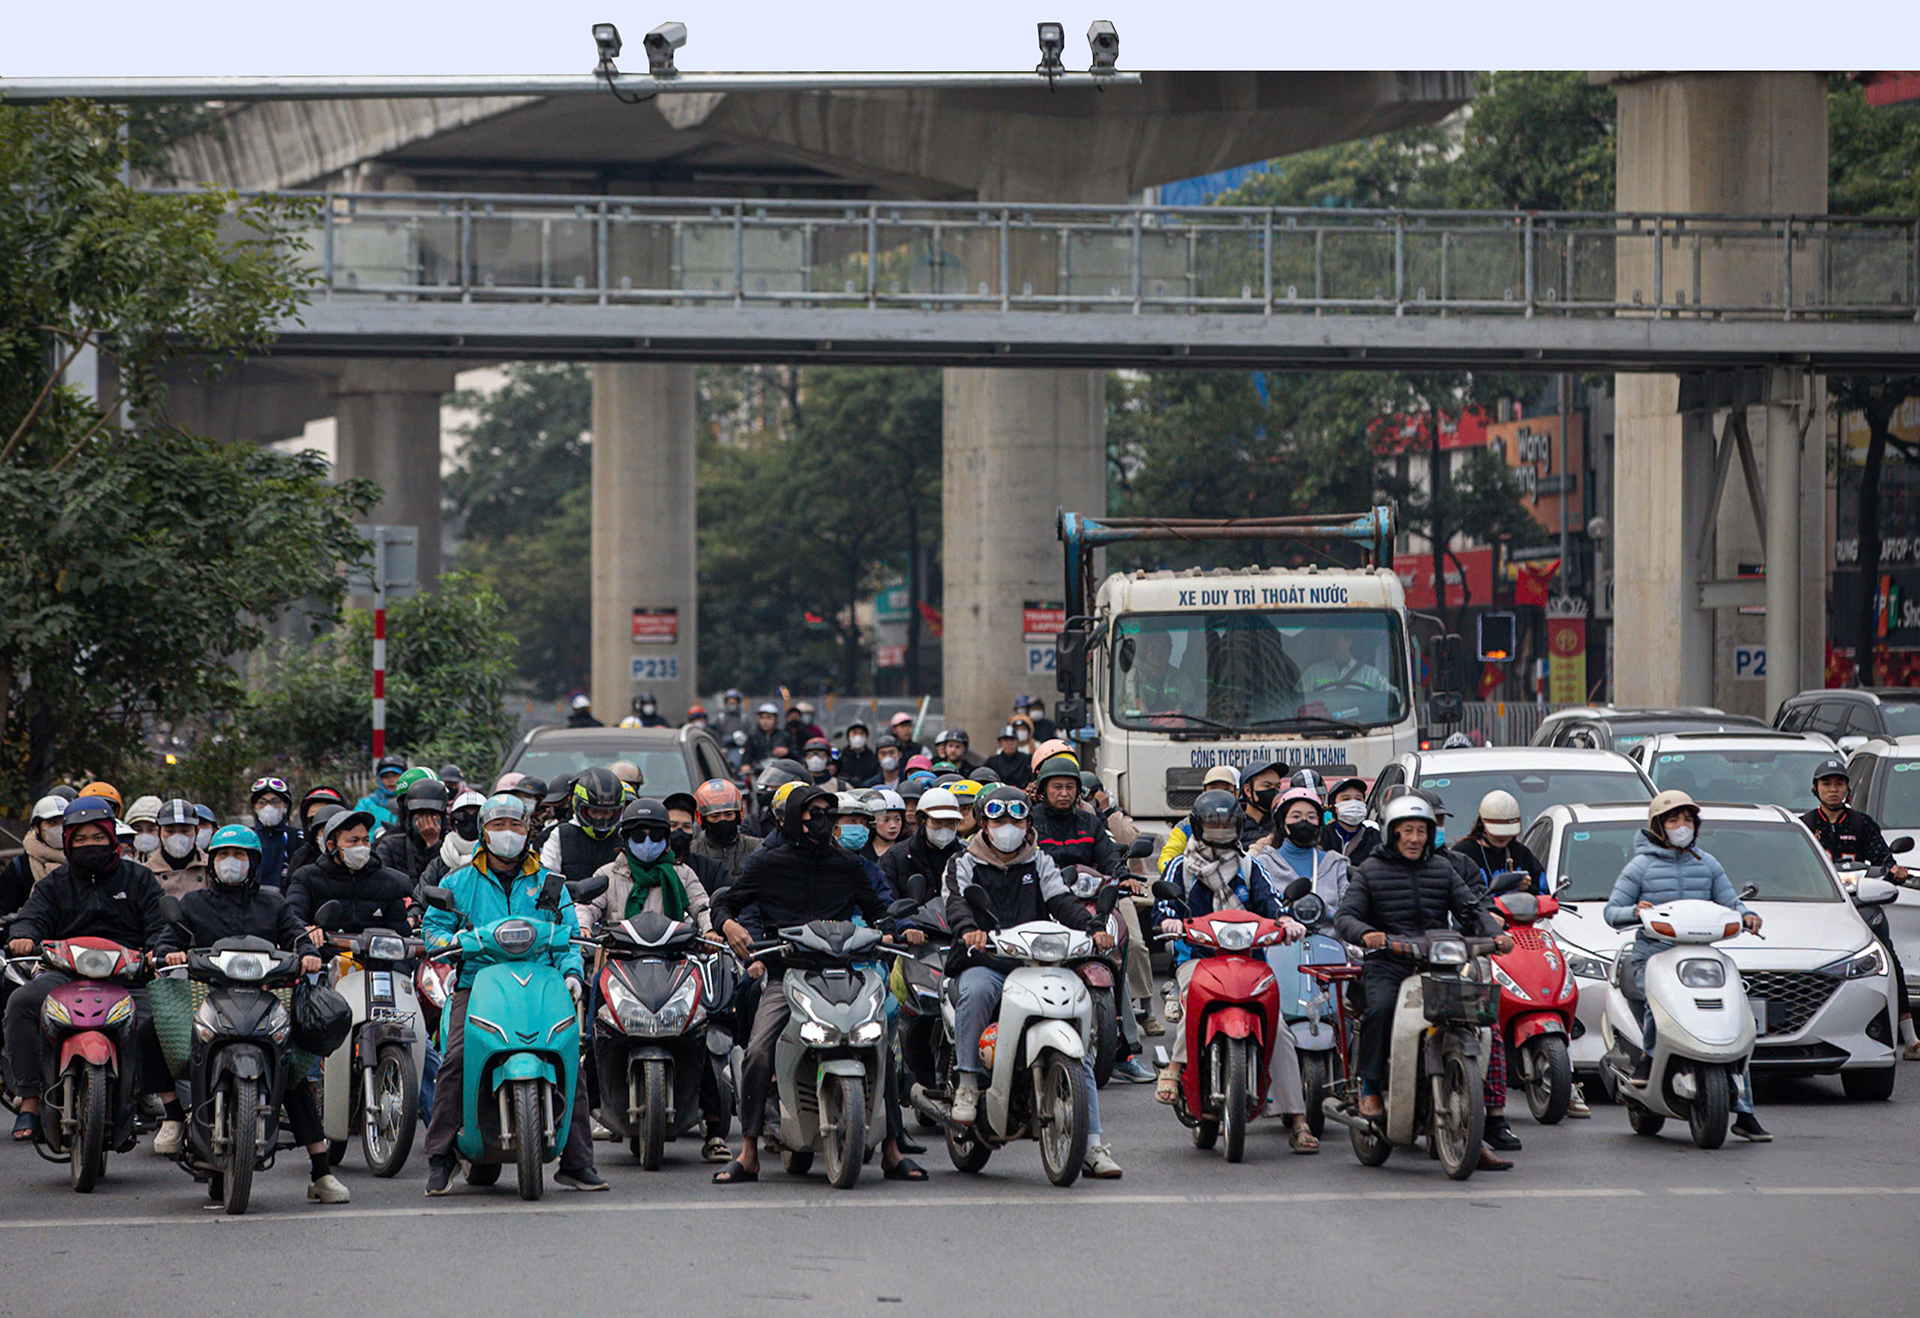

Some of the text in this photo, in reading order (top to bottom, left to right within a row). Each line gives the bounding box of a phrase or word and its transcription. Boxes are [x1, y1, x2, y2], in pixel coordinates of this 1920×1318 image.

[1516, 427, 1551, 474] Wang
[1880, 538, 1908, 561] APTOP
[1178, 583, 1348, 606] XE DUY TRÌ THOÁT NƯỚC
[1190, 746, 1216, 767] CÔNG
